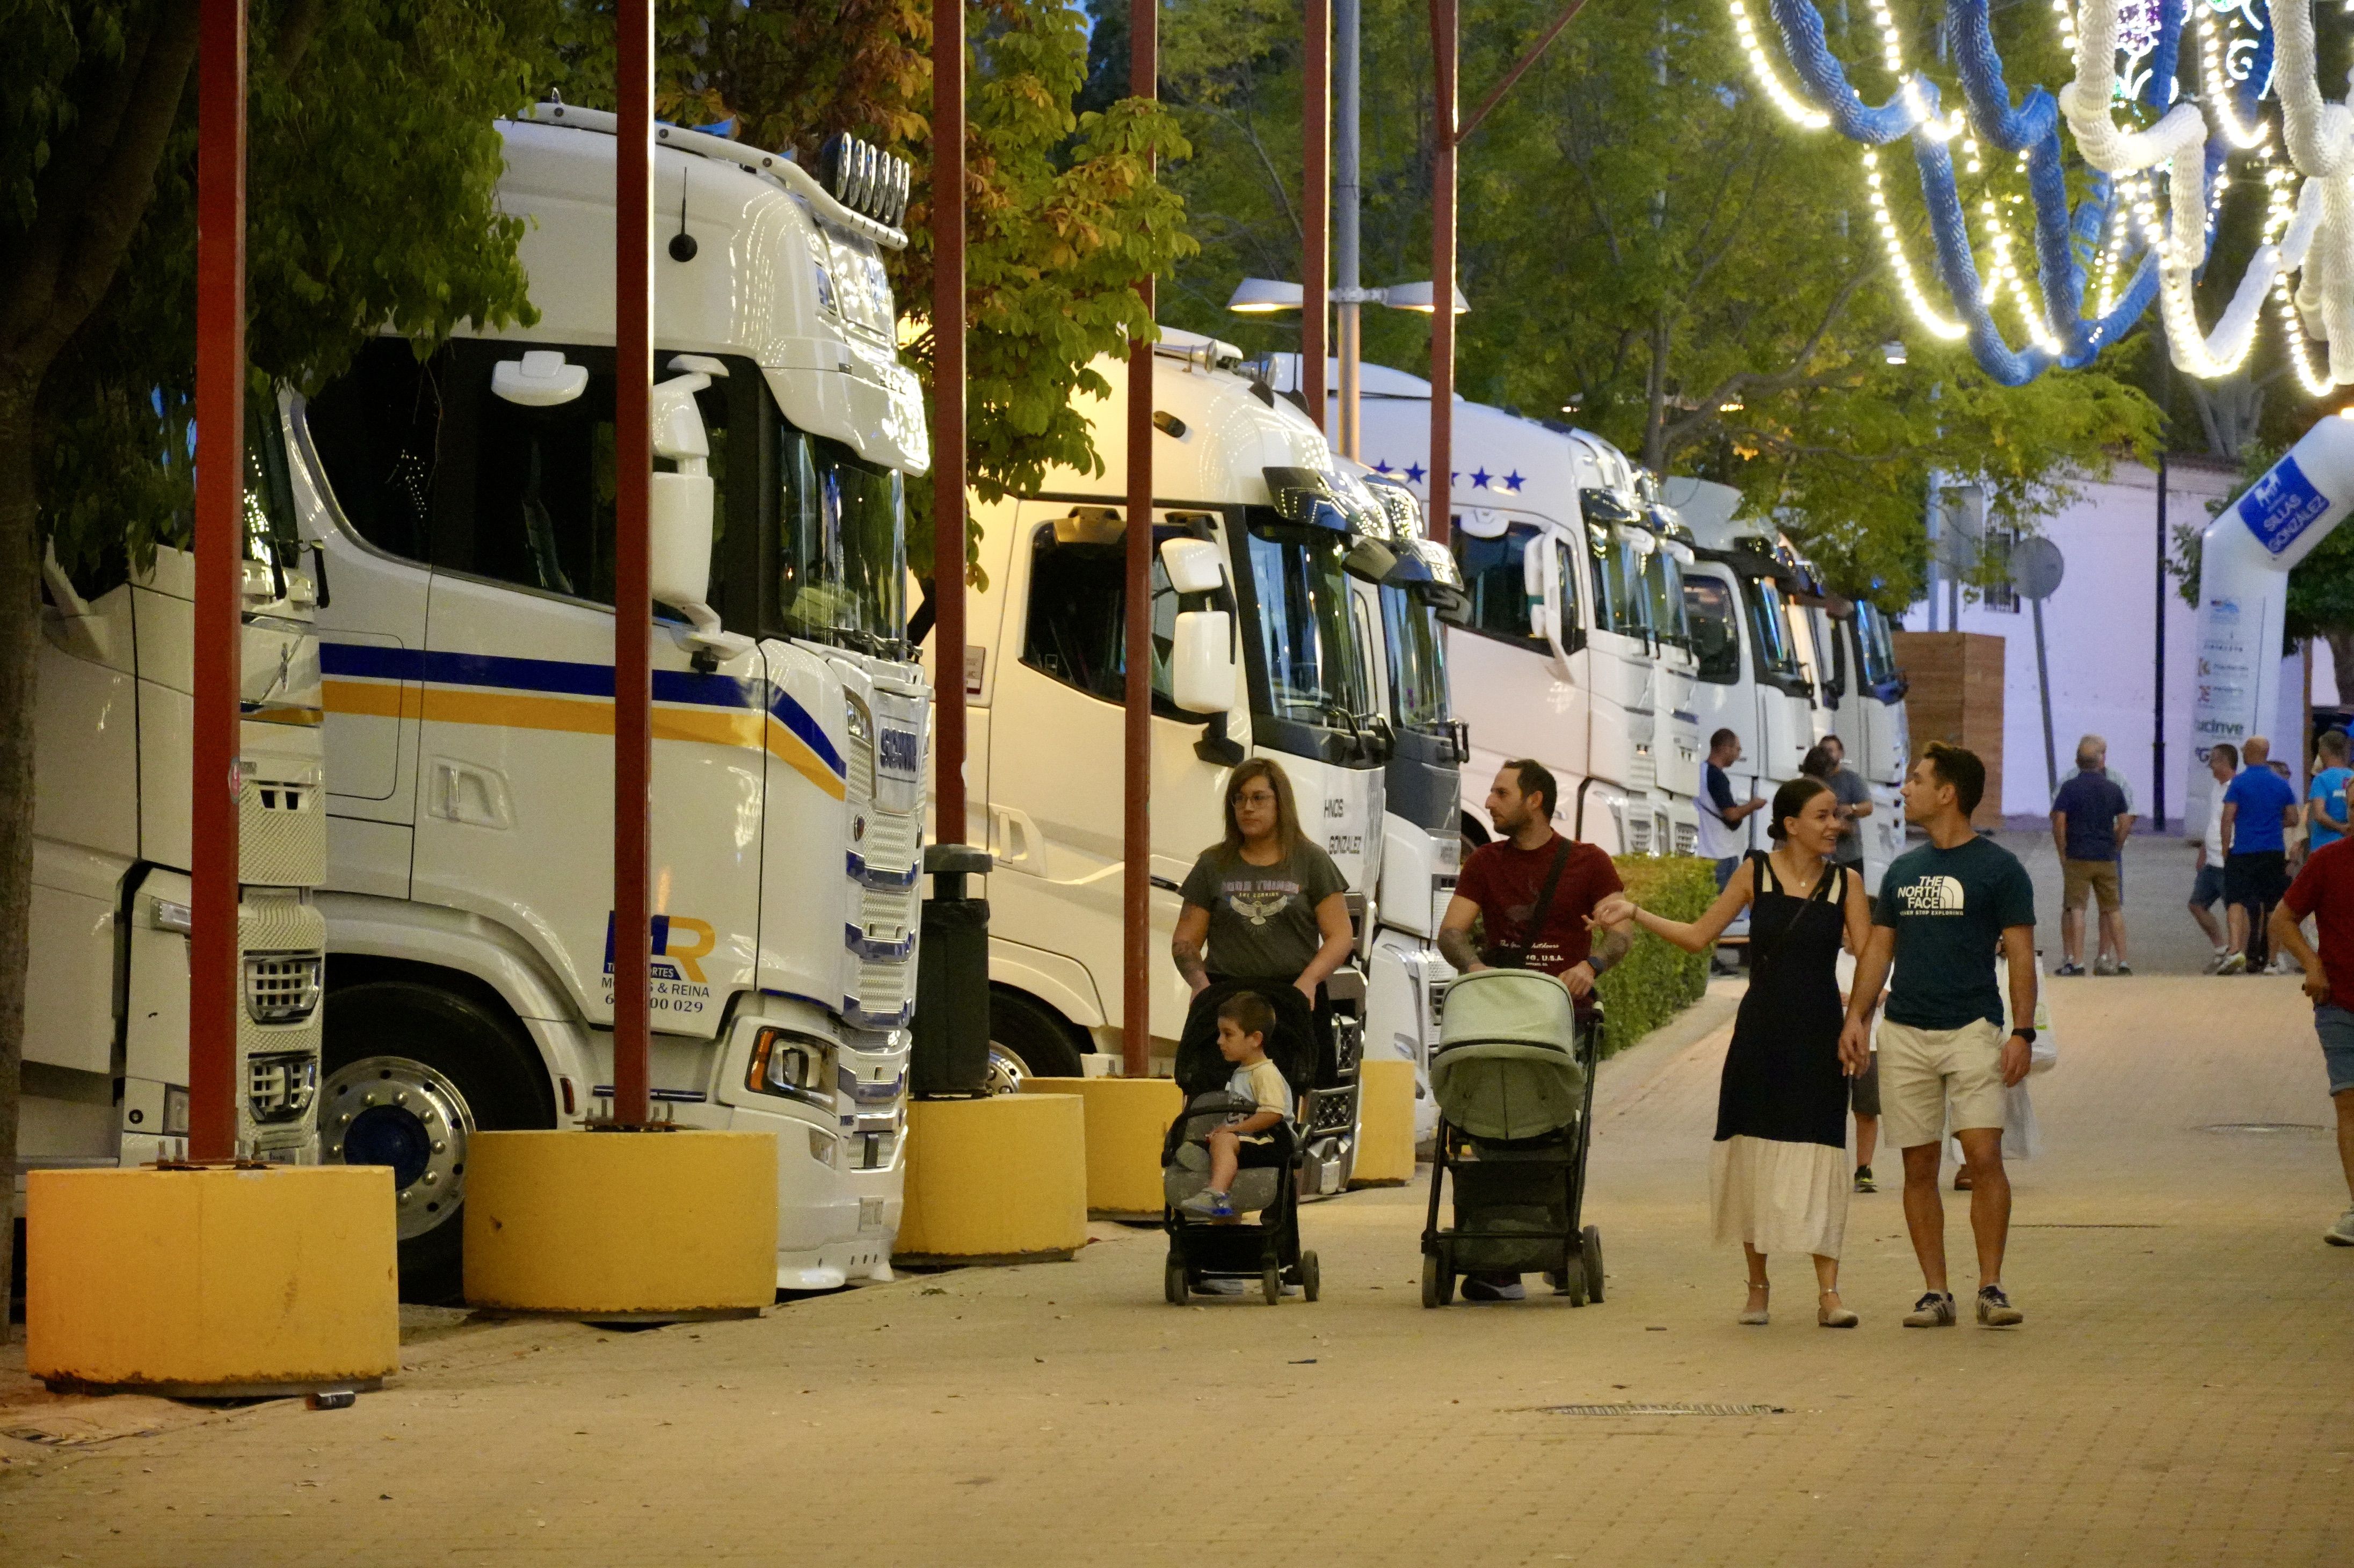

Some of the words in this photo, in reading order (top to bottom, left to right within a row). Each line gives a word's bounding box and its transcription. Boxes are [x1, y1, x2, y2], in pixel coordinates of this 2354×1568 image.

[1919, 876, 1944, 886] THE
[1898, 886, 1941, 898] NORTH
[1908, 897, 1940, 909] FACE
[657, 982, 667, 993] &
[672, 983, 710, 998] REINA
[673, 999, 703, 1013] 029
